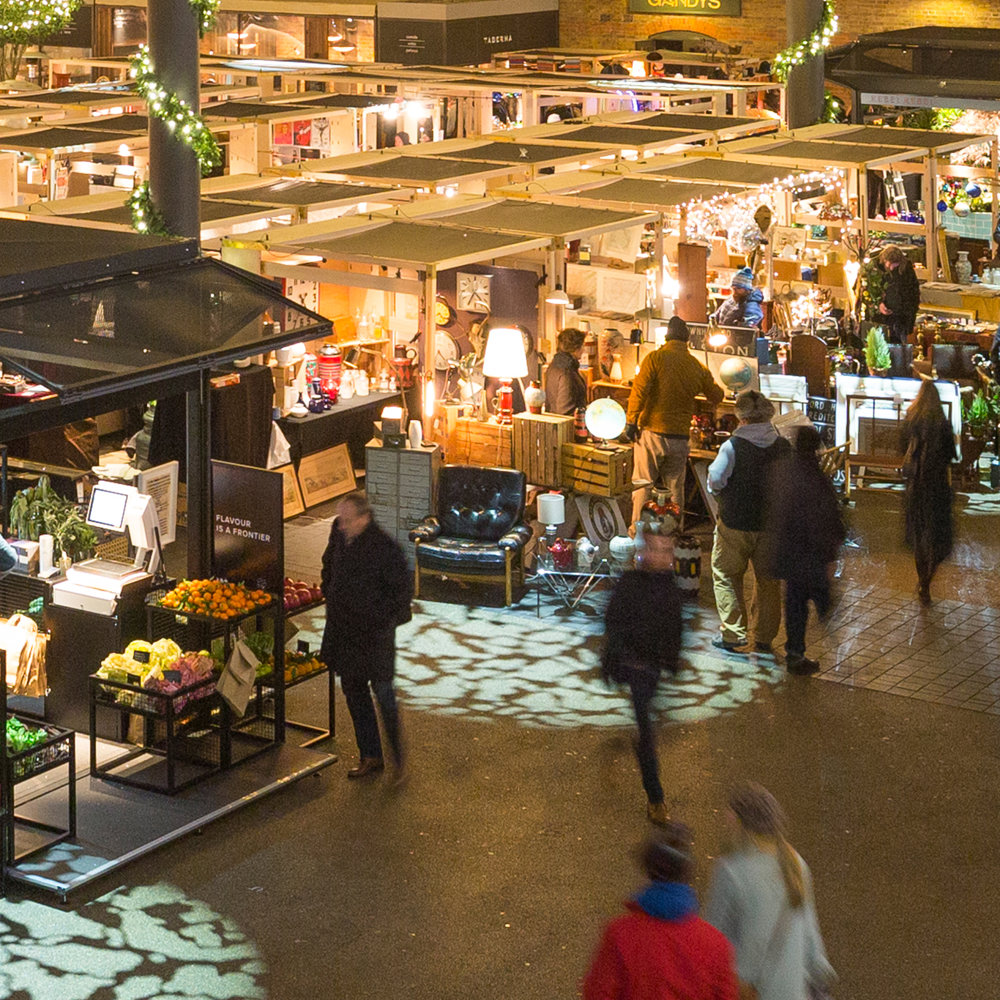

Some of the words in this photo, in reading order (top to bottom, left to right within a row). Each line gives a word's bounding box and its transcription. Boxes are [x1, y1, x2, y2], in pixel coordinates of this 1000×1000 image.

[483, 34, 513, 44] TABERNA
[215, 514, 252, 528] FLAVOUR
[215, 525, 224, 533] IS
[225, 526, 231, 534] A
[232, 527, 271, 543] FRONTIER
